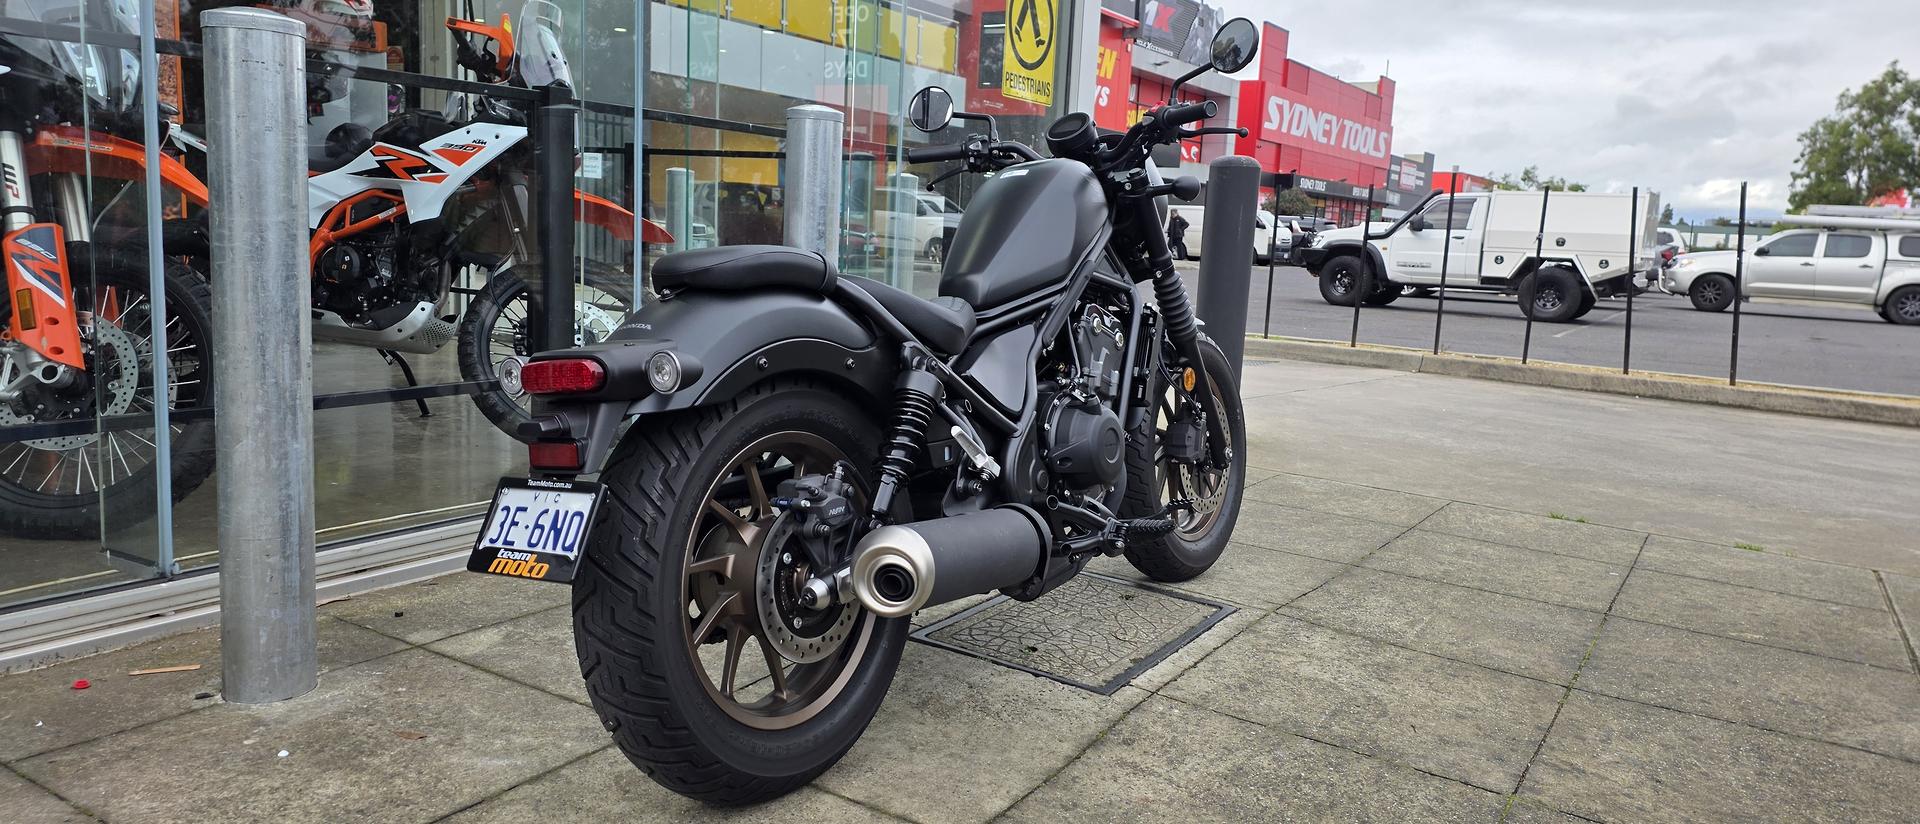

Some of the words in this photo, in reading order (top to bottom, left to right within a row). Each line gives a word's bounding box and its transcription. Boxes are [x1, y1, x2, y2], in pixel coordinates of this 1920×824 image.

[1005, 71, 1051, 97] PEDESTRIANS
[1264, 95, 1343, 146] SYDNEY
[1341, 118, 1388, 159] TOOLS
[528, 479, 573, 489] TeamMoto.com.au
[534, 492, 561, 503] VIC
[497, 548, 532, 561] team
[488, 553, 550, 579] moto
